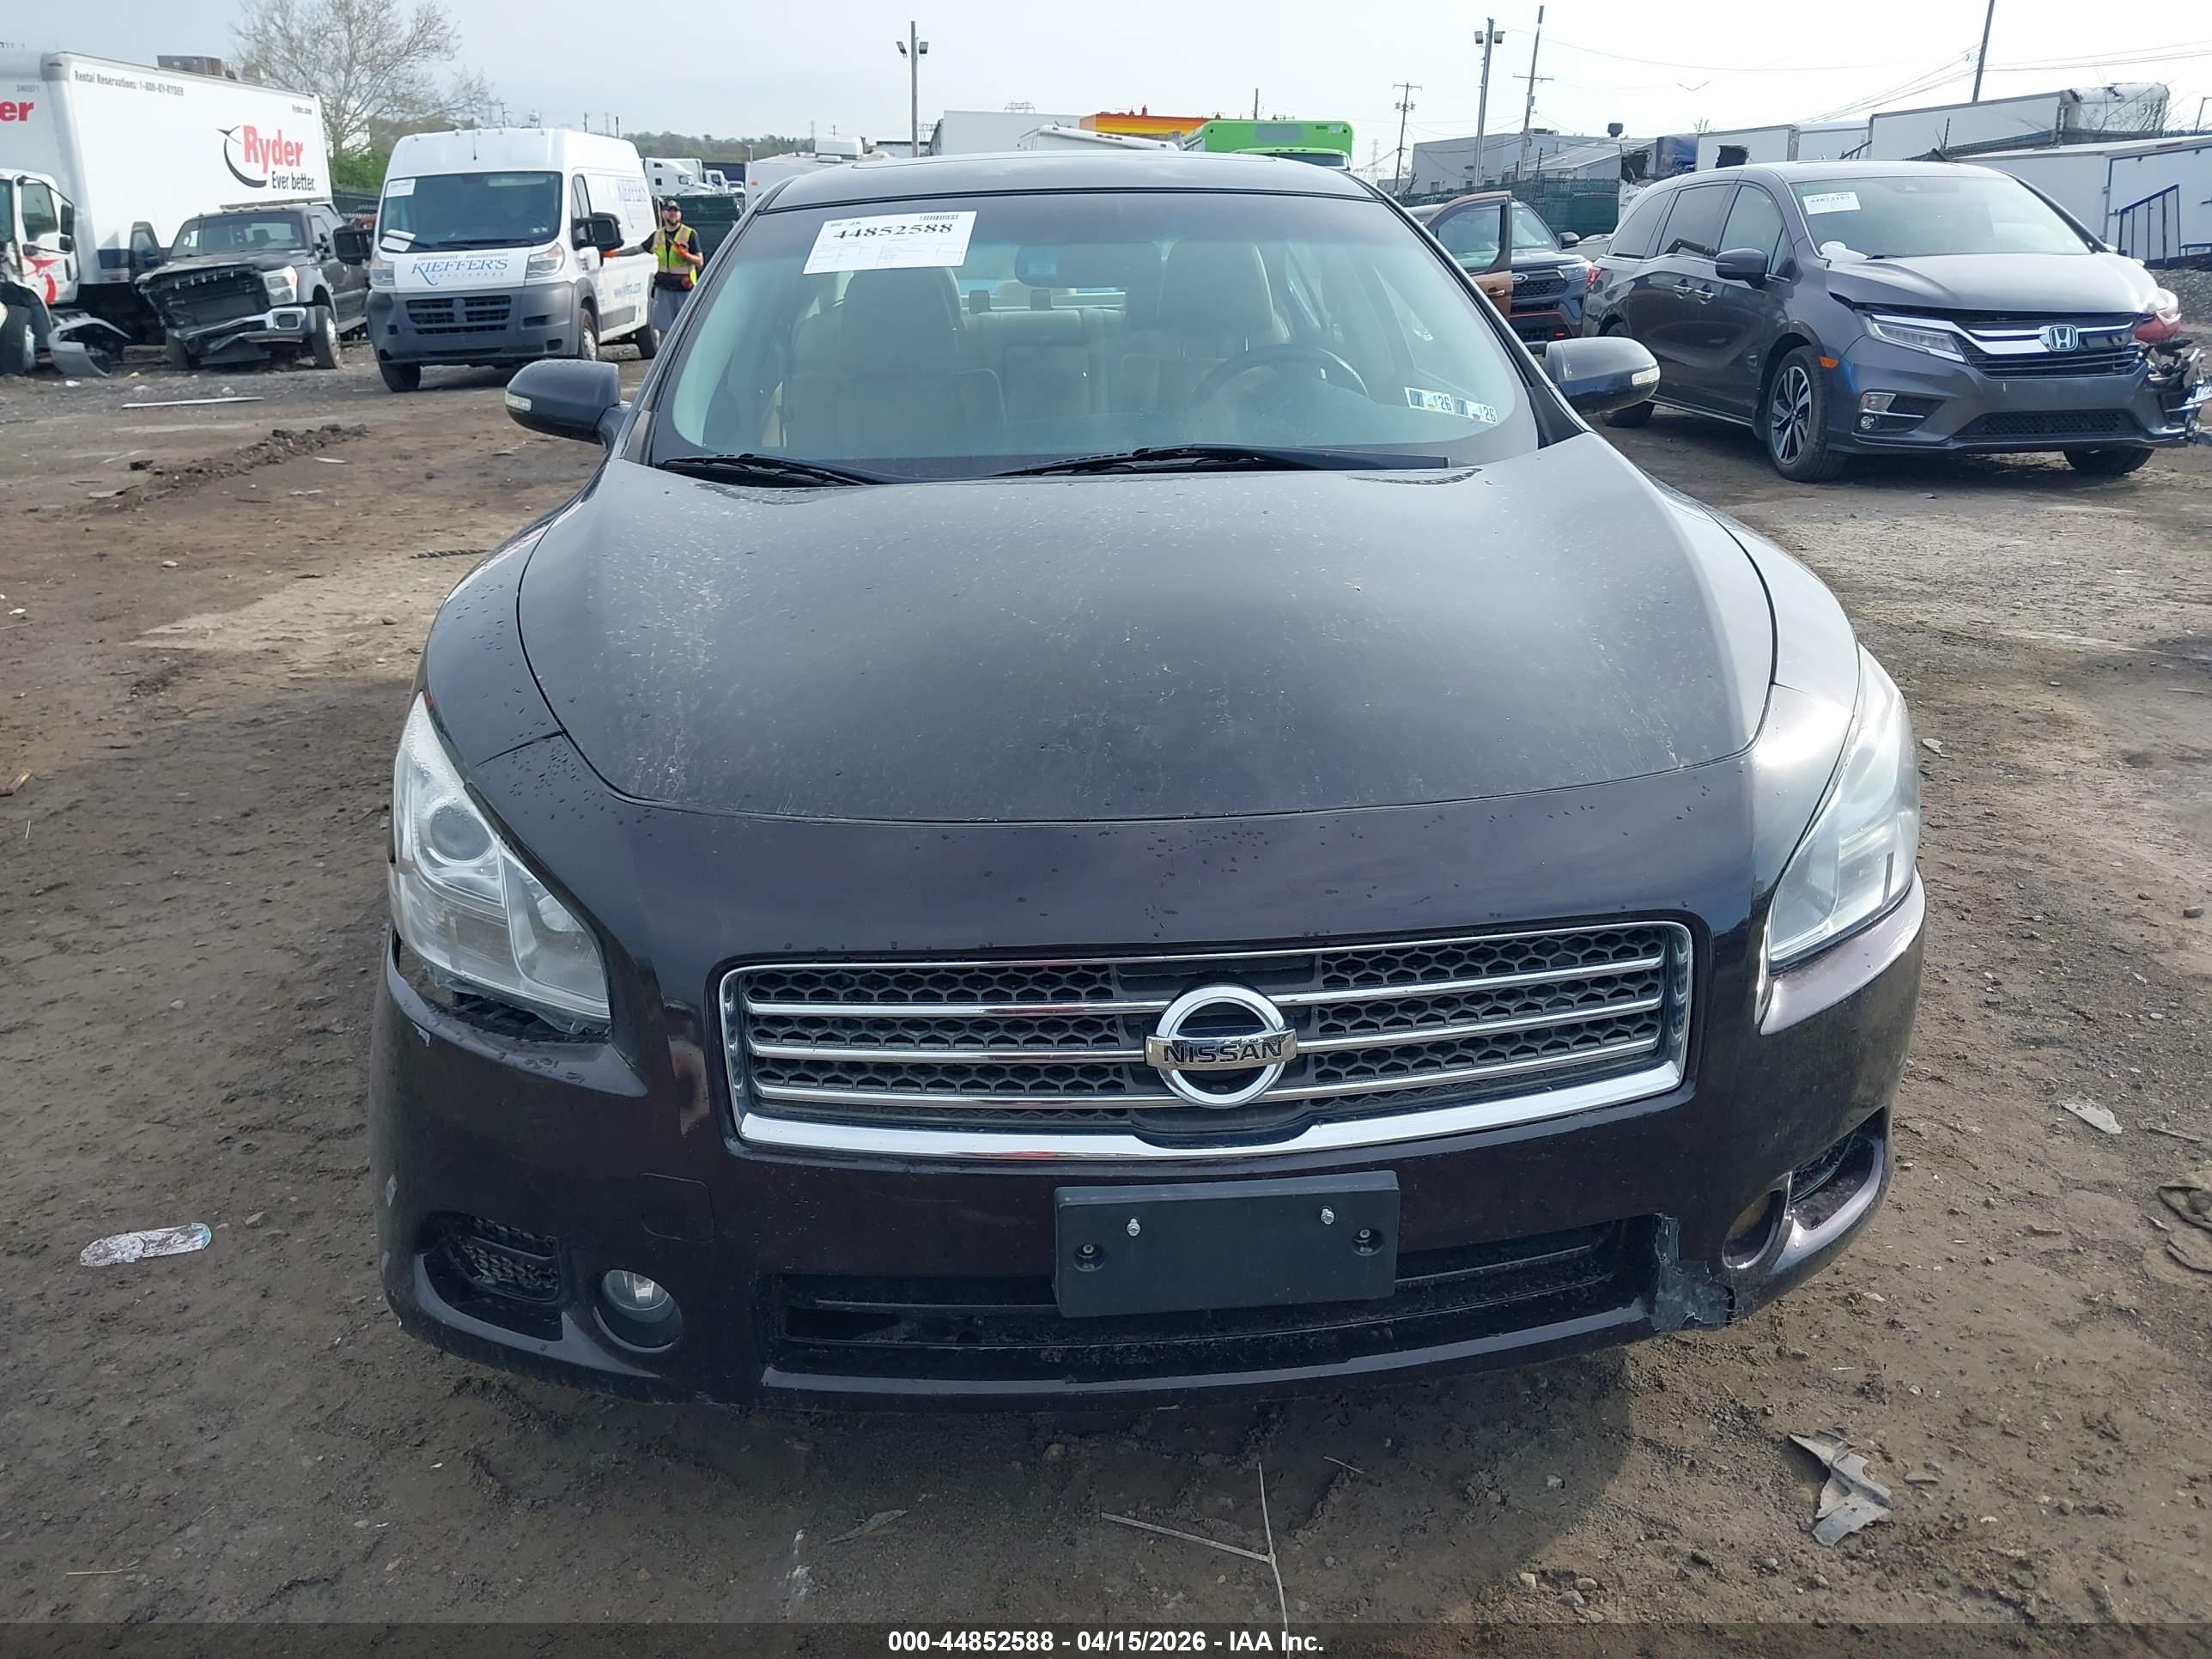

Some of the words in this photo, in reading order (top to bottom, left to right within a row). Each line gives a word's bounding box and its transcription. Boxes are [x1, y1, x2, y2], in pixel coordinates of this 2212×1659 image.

[75, 70, 95, 83] Rental
[242, 124, 304, 174] Ryder
[271, 170, 289, 190] Ever
[291, 172, 316, 191] better.
[833, 223, 953, 240] 44852588
[1164, 1042, 1282, 1064] NISSAN
